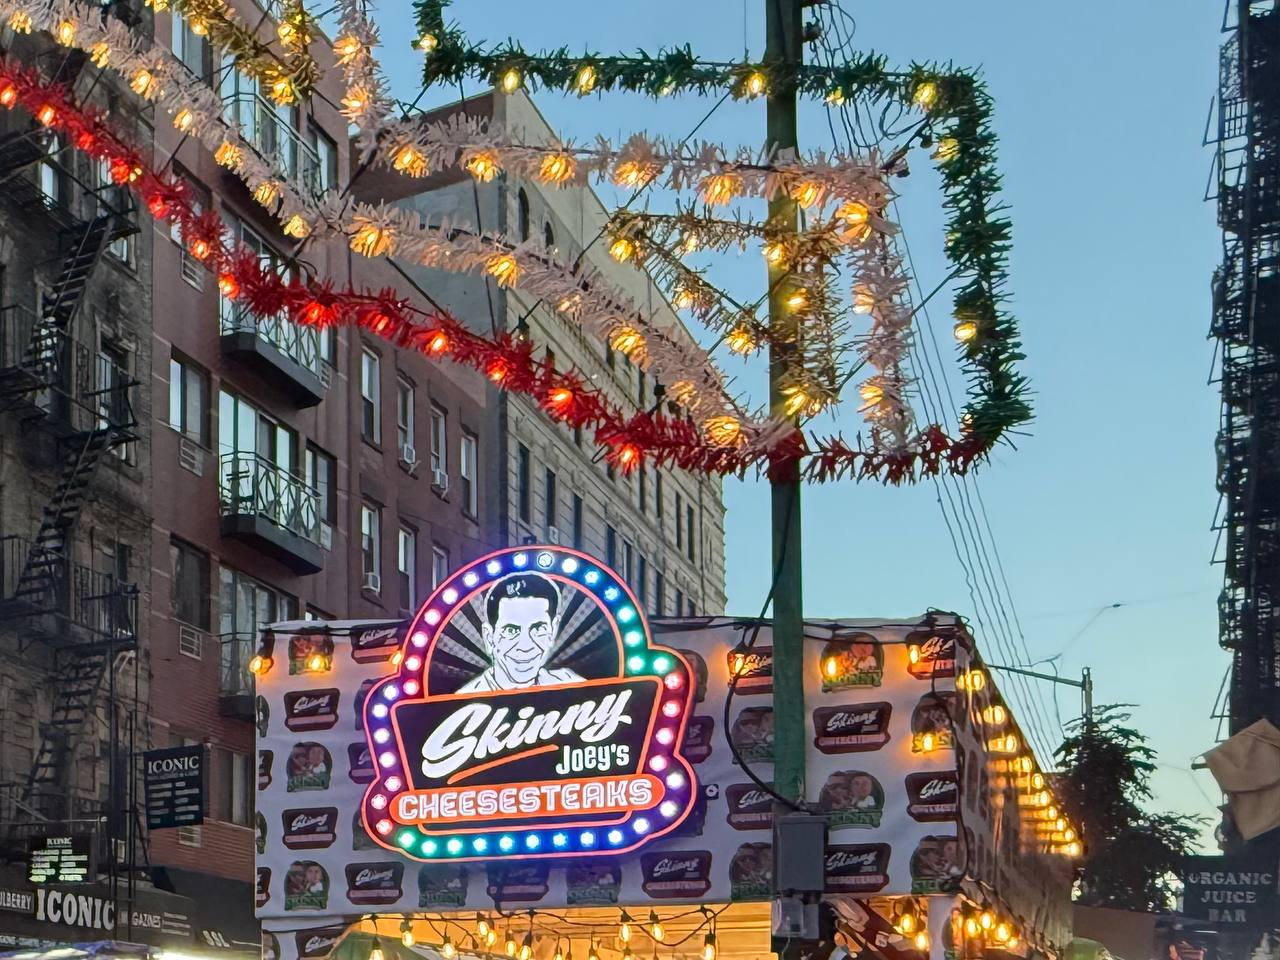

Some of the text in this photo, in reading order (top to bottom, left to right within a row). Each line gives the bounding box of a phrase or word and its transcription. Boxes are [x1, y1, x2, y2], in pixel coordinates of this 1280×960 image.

[421, 690, 632, 779] Skinny
[147, 755, 200, 775] ICONIC
[556, 743, 630, 775] Joey's
[398, 777, 653, 820] CHEESESTEAKS
[1188, 871, 1273, 885] ORGANIC
[36, 888, 115, 931] ICONIC
[1200, 891, 1257, 904] JUICE
[1208, 908, 1247, 923] BAR
